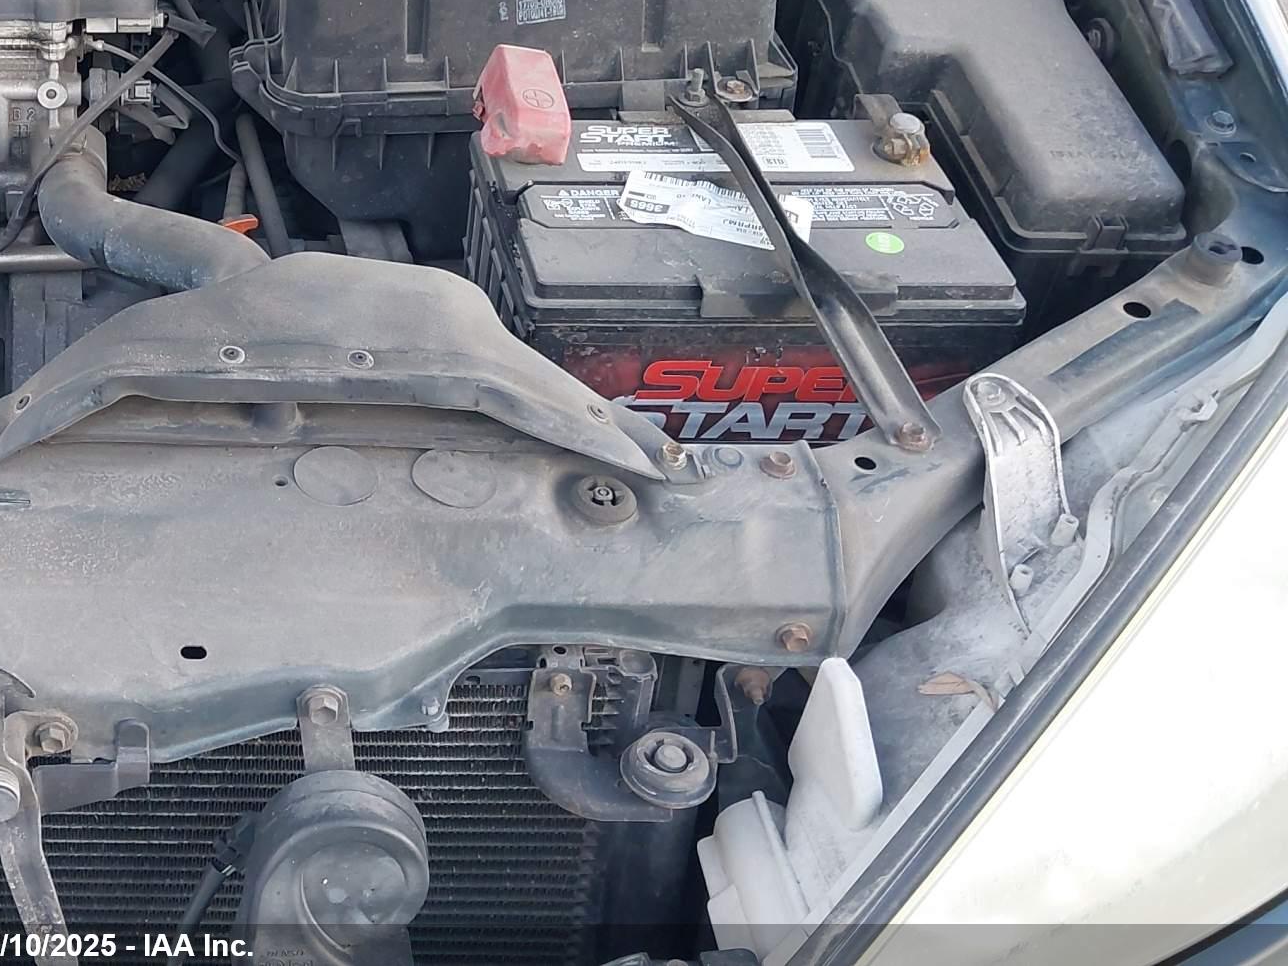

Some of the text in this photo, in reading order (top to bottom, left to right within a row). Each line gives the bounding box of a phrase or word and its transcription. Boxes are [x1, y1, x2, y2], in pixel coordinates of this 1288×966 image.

[587, 125, 670, 134] SUPER
[580, 134, 672, 144] START
[633, 360, 859, 402] SUPE
